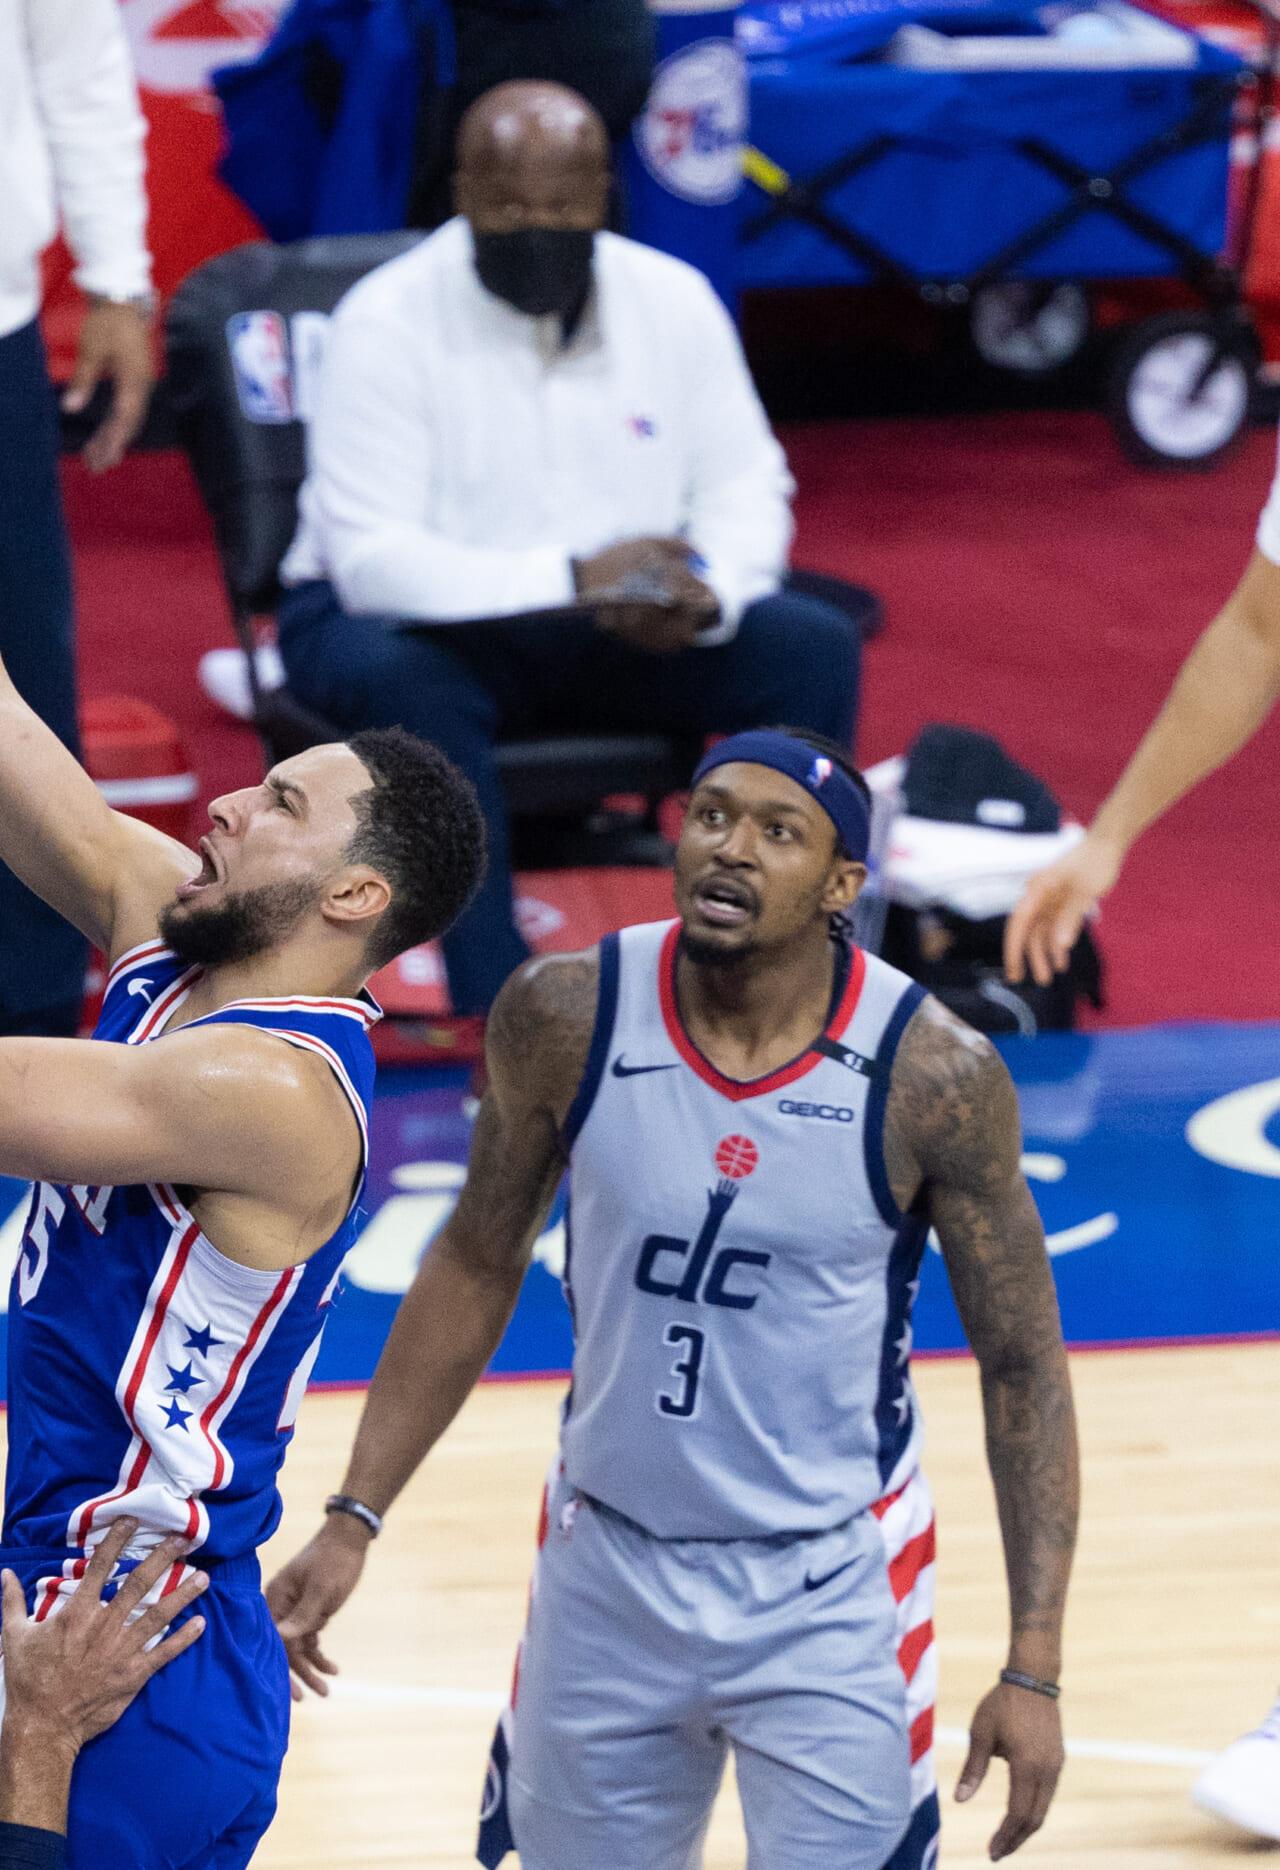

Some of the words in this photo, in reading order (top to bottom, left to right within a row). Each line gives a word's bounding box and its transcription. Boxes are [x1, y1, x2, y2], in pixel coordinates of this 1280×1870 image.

[778, 1099, 855, 1123] GEICO
[634, 1185, 771, 1310] dc
[658, 1321, 705, 1419] 3
